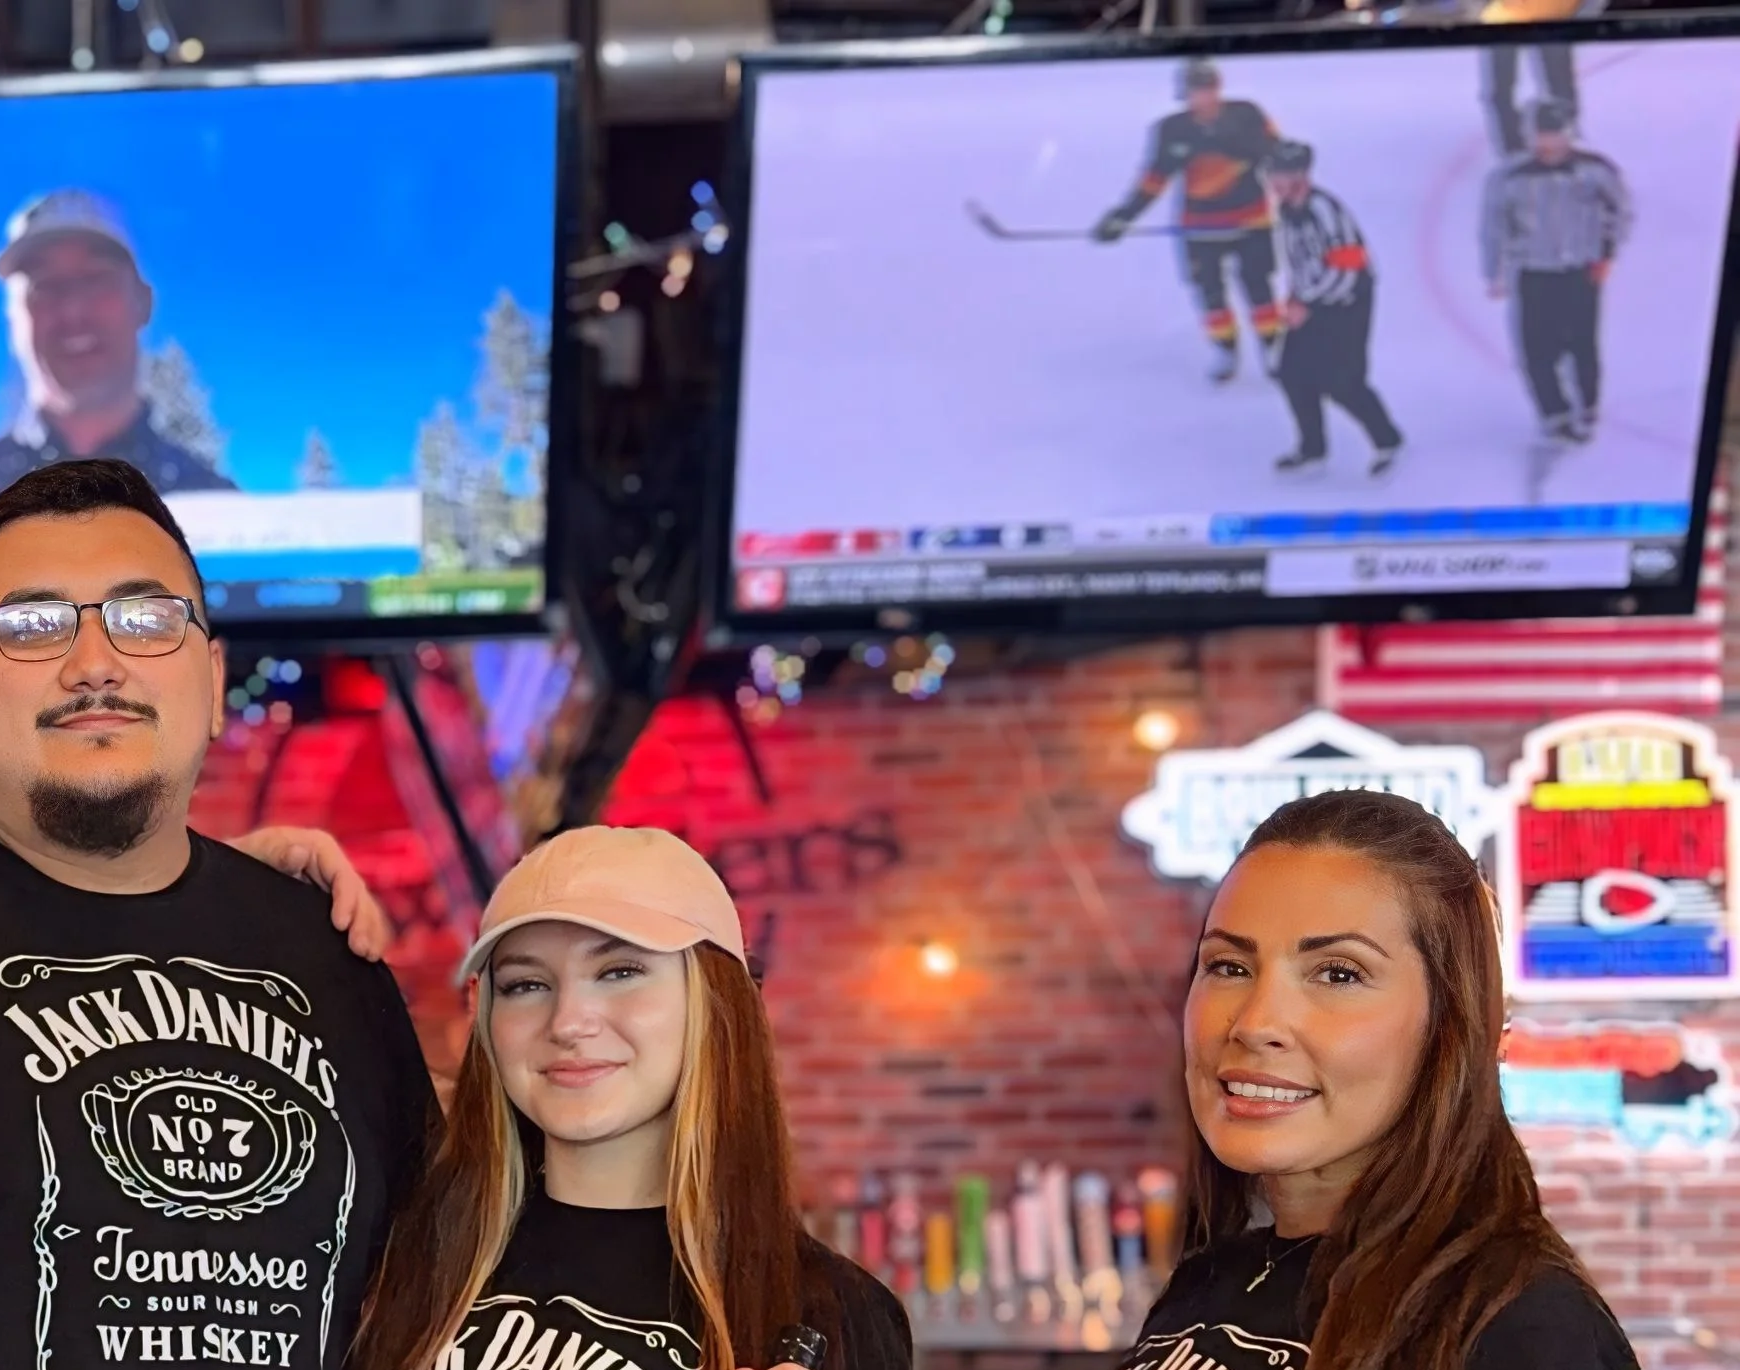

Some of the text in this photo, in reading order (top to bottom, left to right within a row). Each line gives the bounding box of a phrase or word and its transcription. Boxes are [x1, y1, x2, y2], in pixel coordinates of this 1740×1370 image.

[4, 969, 338, 1109] JACK DANIEL'S
[175, 1094, 217, 1113] OLD
[163, 1158, 243, 1183] BRAND
[93, 1225, 308, 1291] Tennessee
[147, 1295, 206, 1312] SOUR
[96, 1322, 300, 1367] WHISKEY
